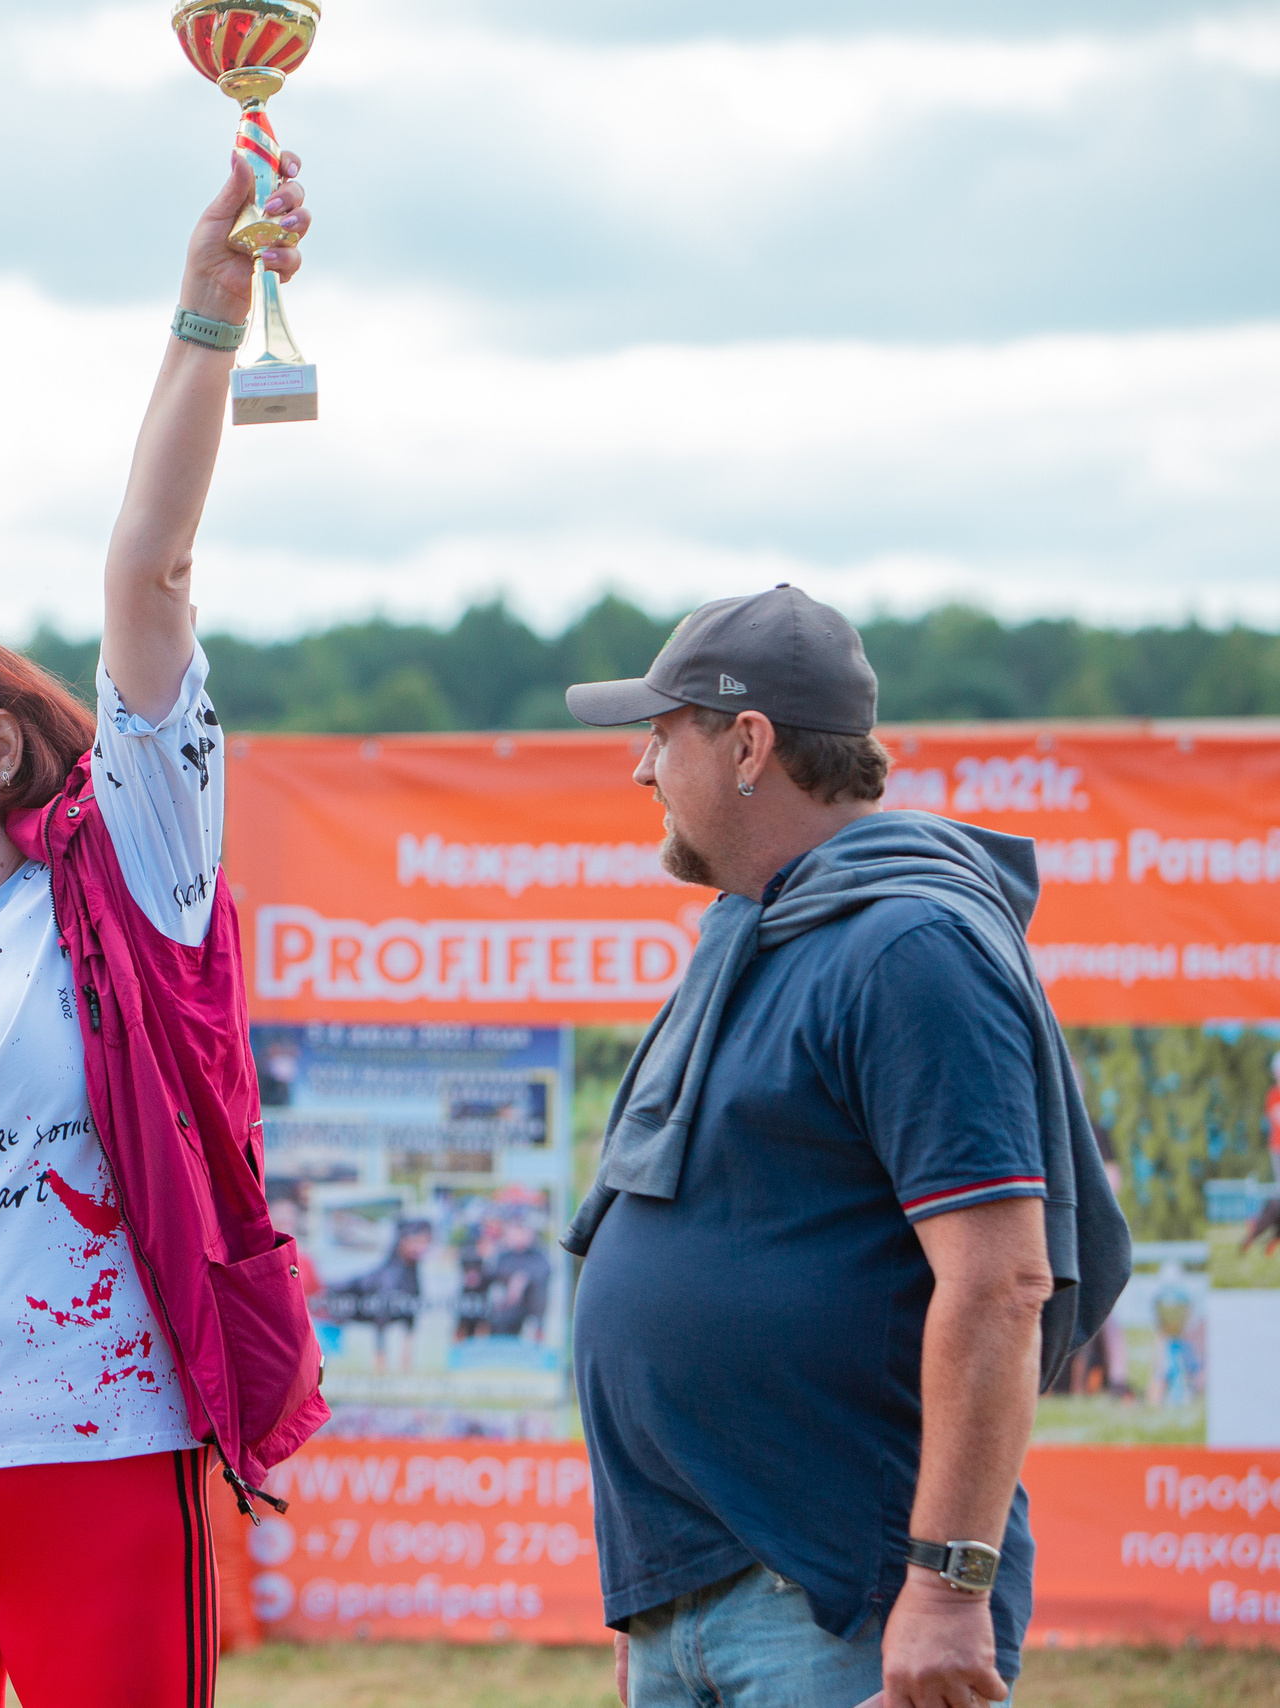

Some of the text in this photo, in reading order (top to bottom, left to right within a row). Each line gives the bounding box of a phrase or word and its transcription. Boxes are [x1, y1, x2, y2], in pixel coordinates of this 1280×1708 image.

[397, 833, 675, 897] Межрегион
[260, 909, 688, 997] PROFIFEED
[57, 987, 73, 1019] 20XX
